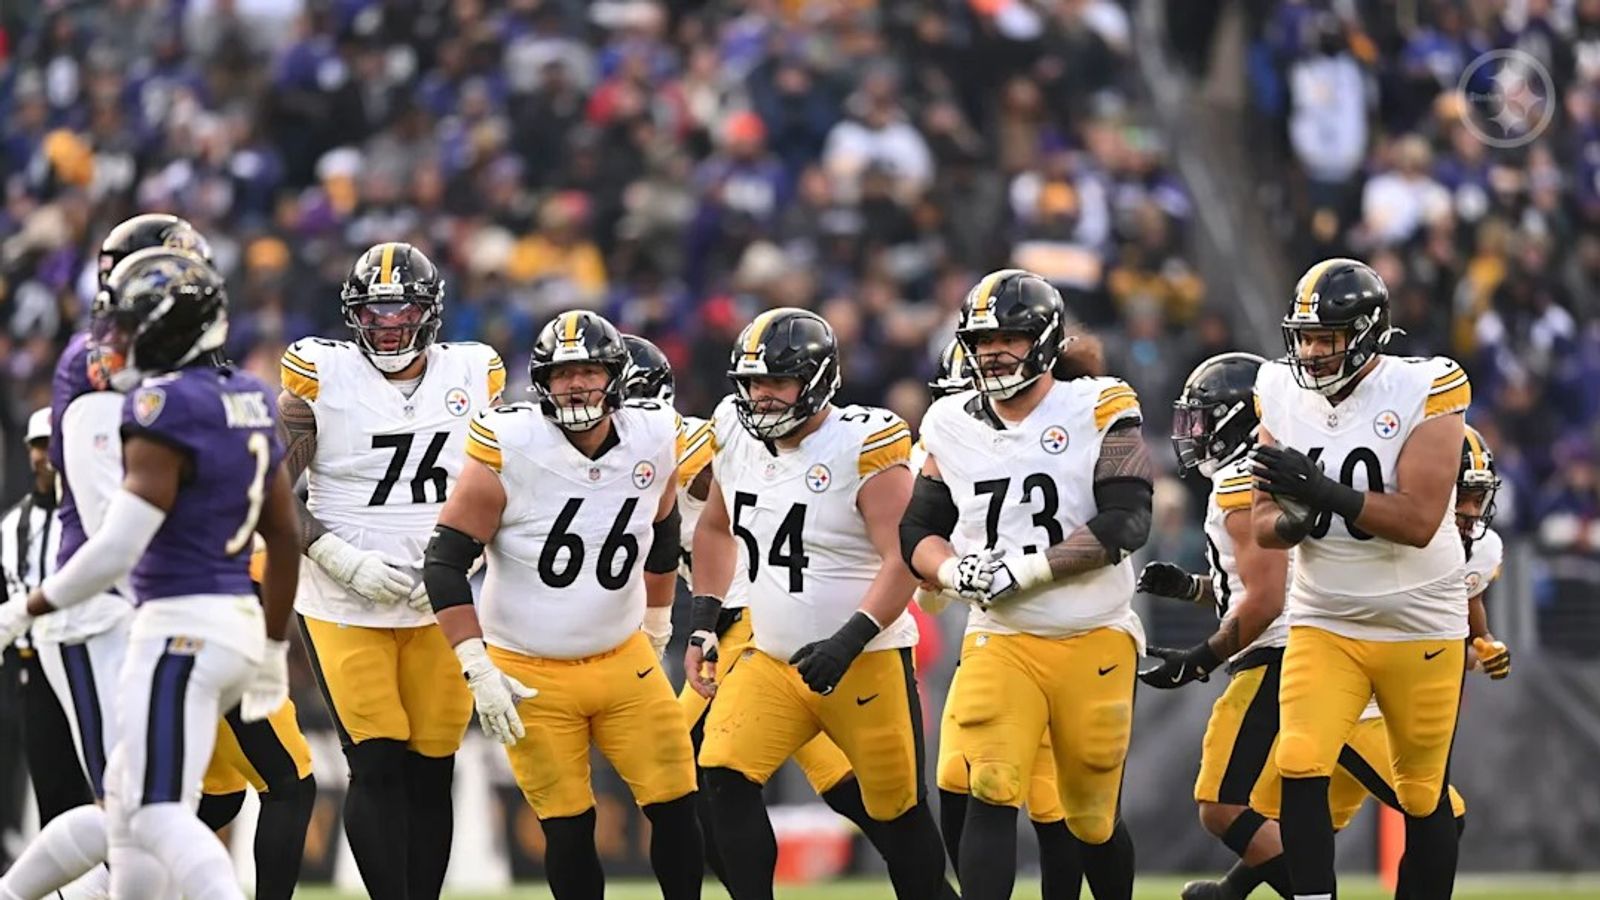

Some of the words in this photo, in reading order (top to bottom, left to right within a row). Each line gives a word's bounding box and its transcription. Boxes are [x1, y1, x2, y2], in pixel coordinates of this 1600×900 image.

[371, 266, 401, 285] 76
[368, 432, 449, 506] 76
[537, 497, 639, 591] 66
[732, 490, 810, 593] 54
[974, 472, 1065, 555] 73
